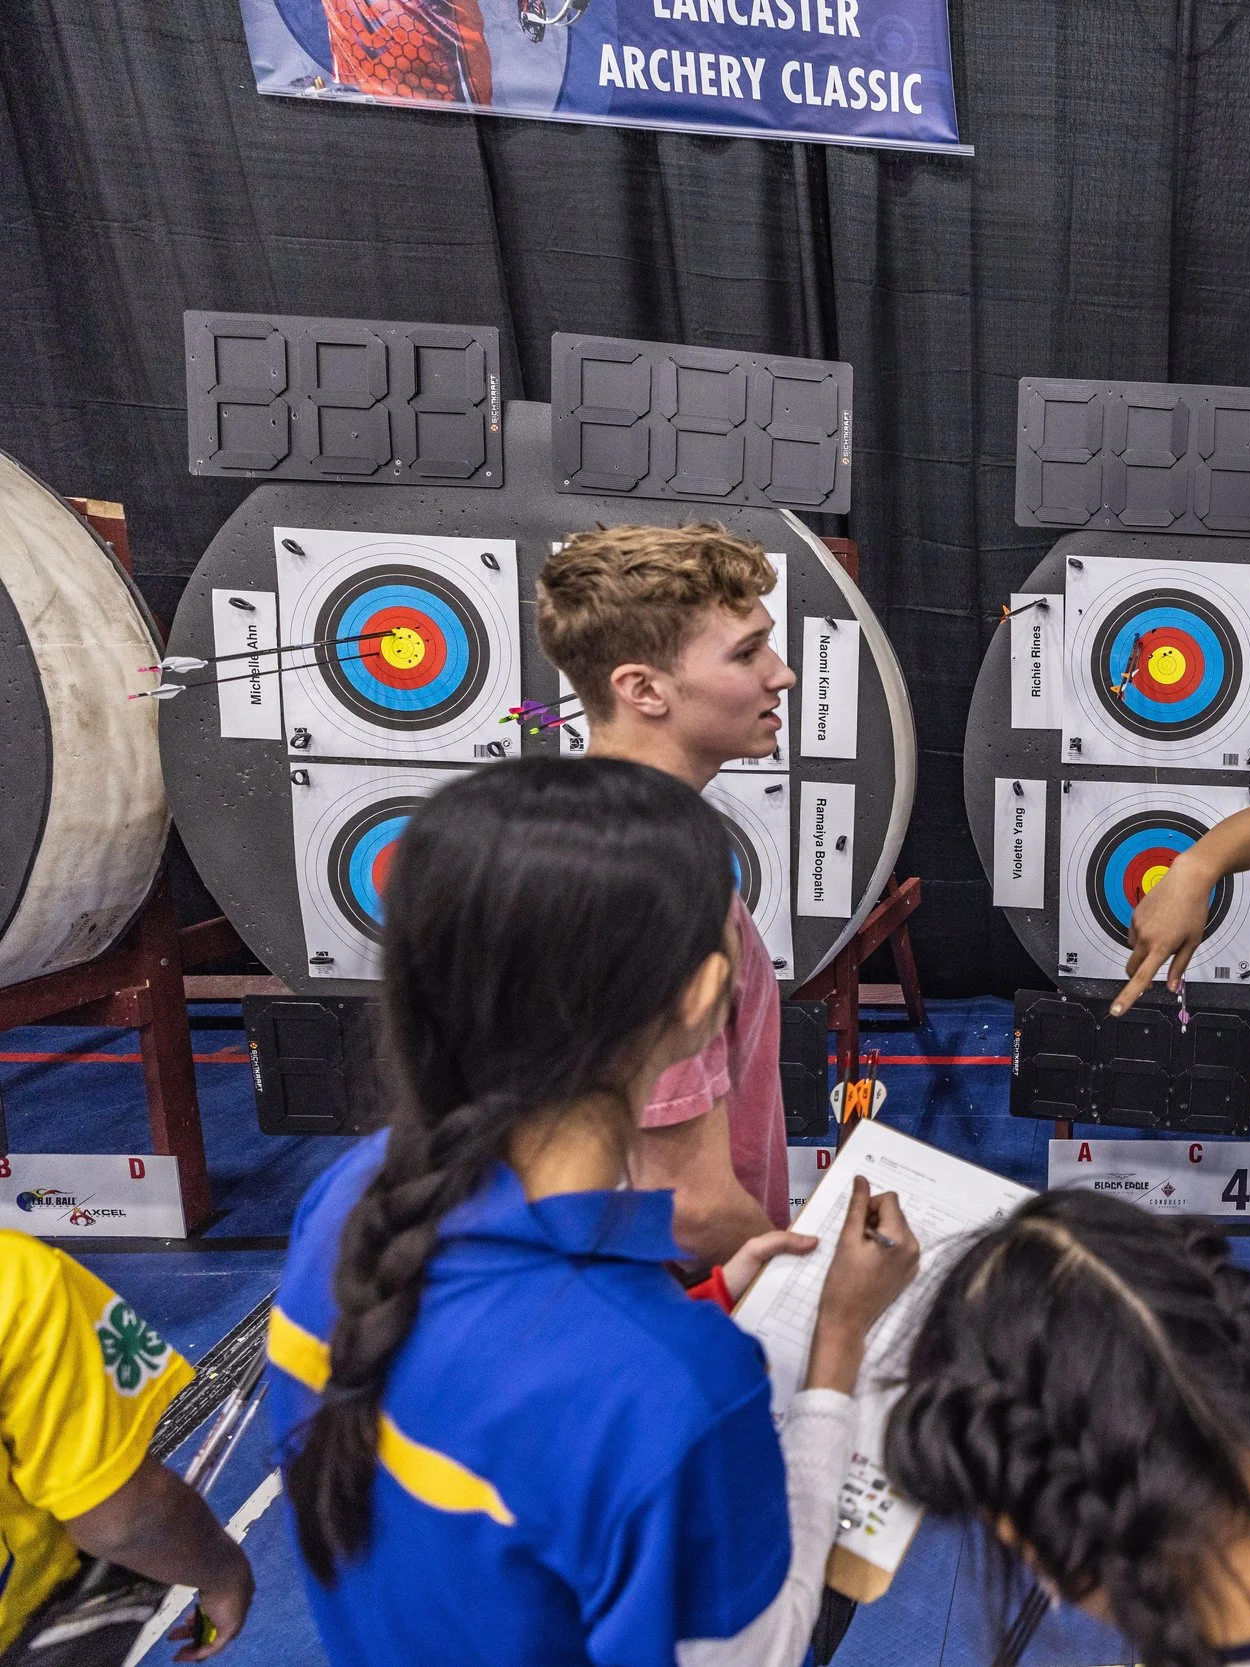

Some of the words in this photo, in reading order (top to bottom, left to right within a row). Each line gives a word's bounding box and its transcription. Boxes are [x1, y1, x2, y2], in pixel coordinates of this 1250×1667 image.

[599, 44, 766, 100] ARCHERY
[782, 60, 923, 114] CLASSIC
[246, 625, 259, 650] Ahn
[819, 635, 831, 673] Naomi
[1031, 625, 1041, 658] Rines
[248, 654, 262, 705] Michelle
[818, 677, 830, 700] Kim
[1031, 662, 1042, 698] Richie
[817, 703, 829, 741] Rivera
[813, 799, 827, 847] Ramaiya
[1013, 807, 1026, 835] Yang
[1013, 838, 1023, 880] Violette
[812, 851, 826, 902] Boopathi
[0, 1157, 12, 1178] B
[129, 1157, 146, 1179] D
[817, 1150, 831, 1170] D
[1077, 1142, 1092, 1162] A
[1189, 1143, 1203, 1163] C
[56, 1196, 77, 1206] BALL
[1094, 1181, 1122, 1190] BLACK
[1125, 1181, 1149, 1190] EAGLE
